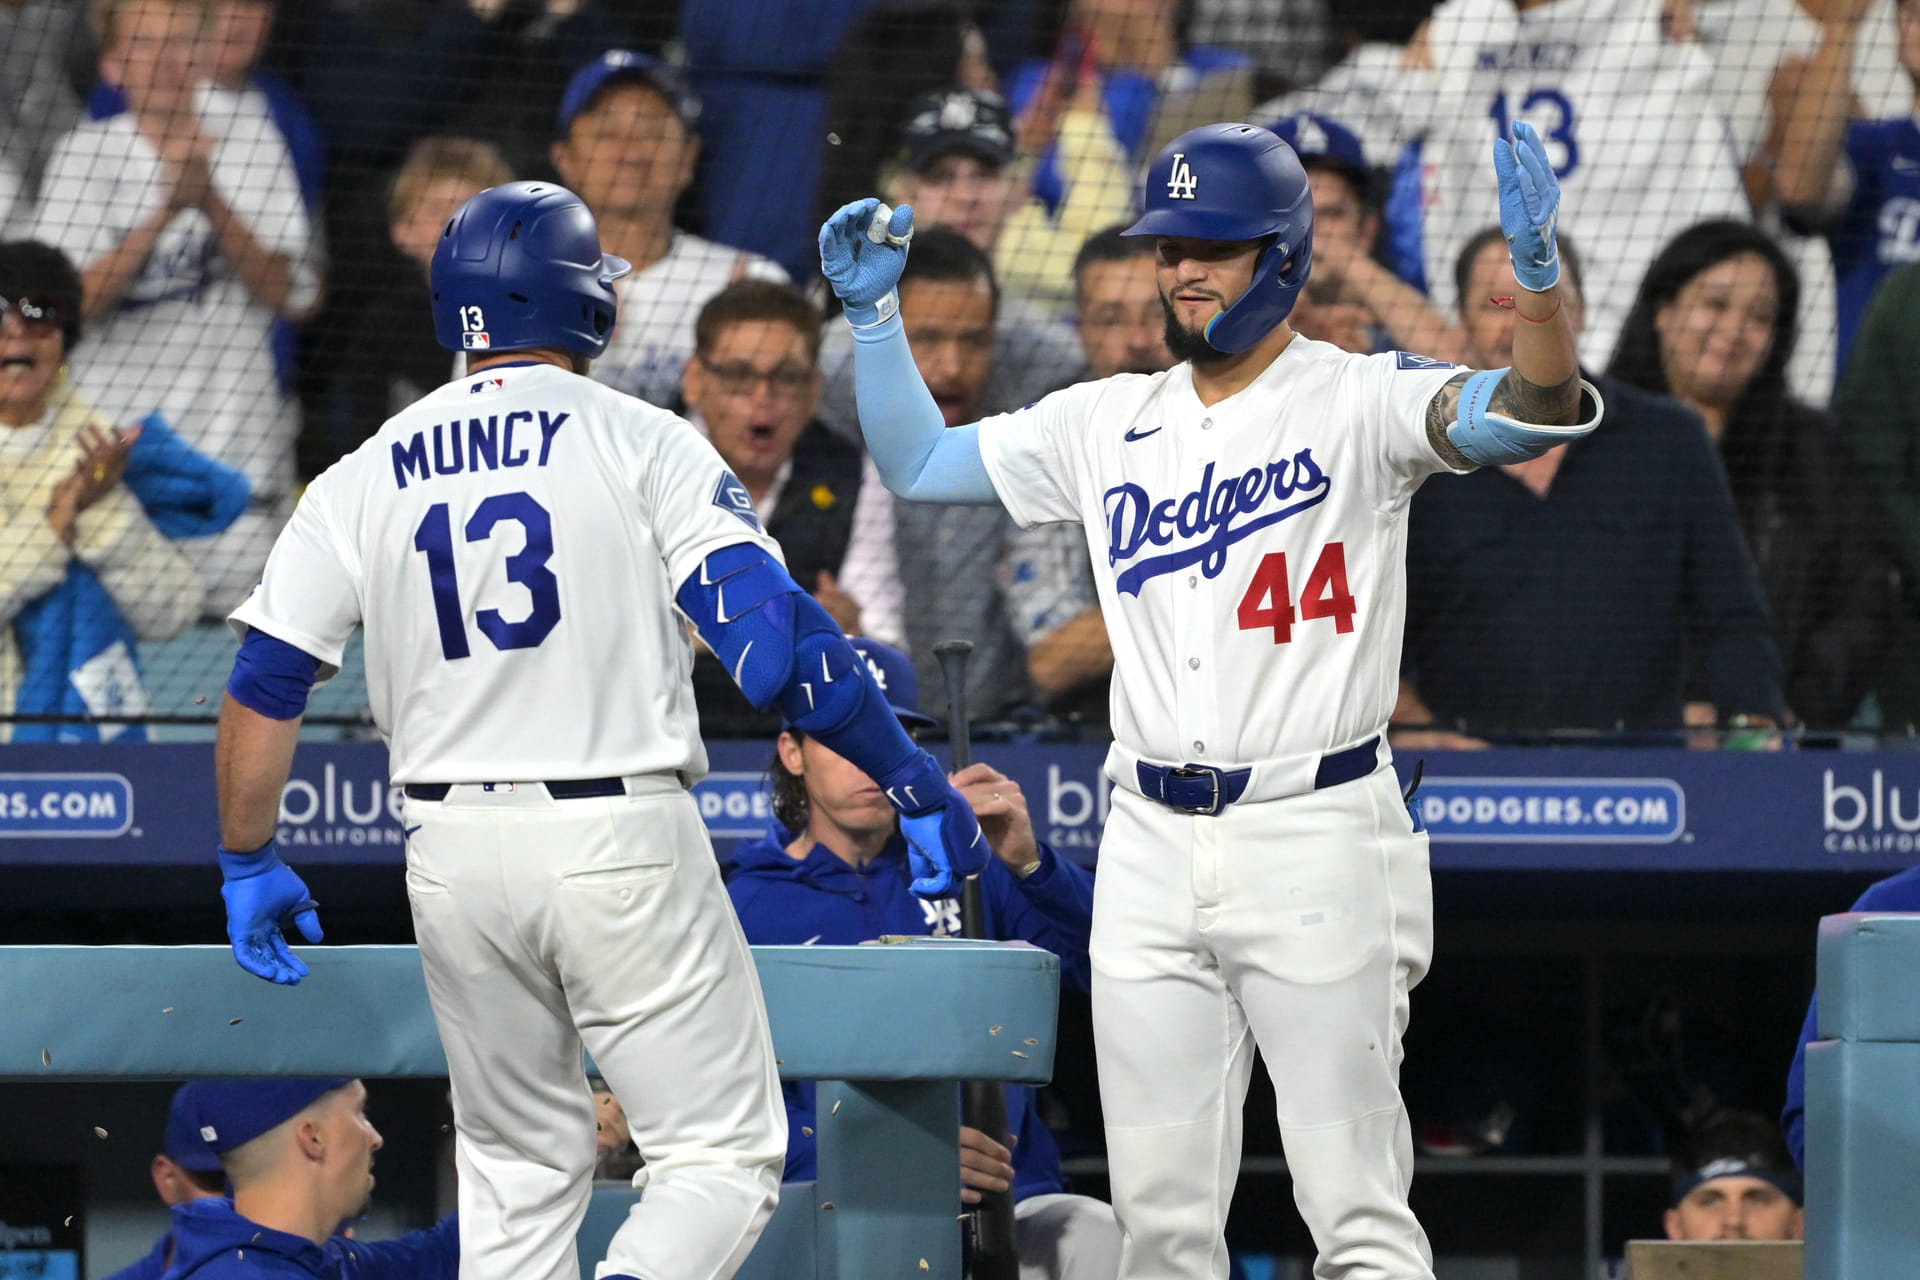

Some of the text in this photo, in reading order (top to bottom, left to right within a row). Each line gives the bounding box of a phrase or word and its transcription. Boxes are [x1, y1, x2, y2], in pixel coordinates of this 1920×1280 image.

[1167, 153, 1198, 199] LA
[1489, 88, 1579, 180] 13
[459, 305, 485, 332] 13
[391, 410, 571, 490] MUNCY
[1103, 447, 1331, 582] Dodgers
[414, 491, 562, 661] 13
[1237, 541, 1357, 645] 44
[1424, 796, 1669, 824] DODGERS.COM
